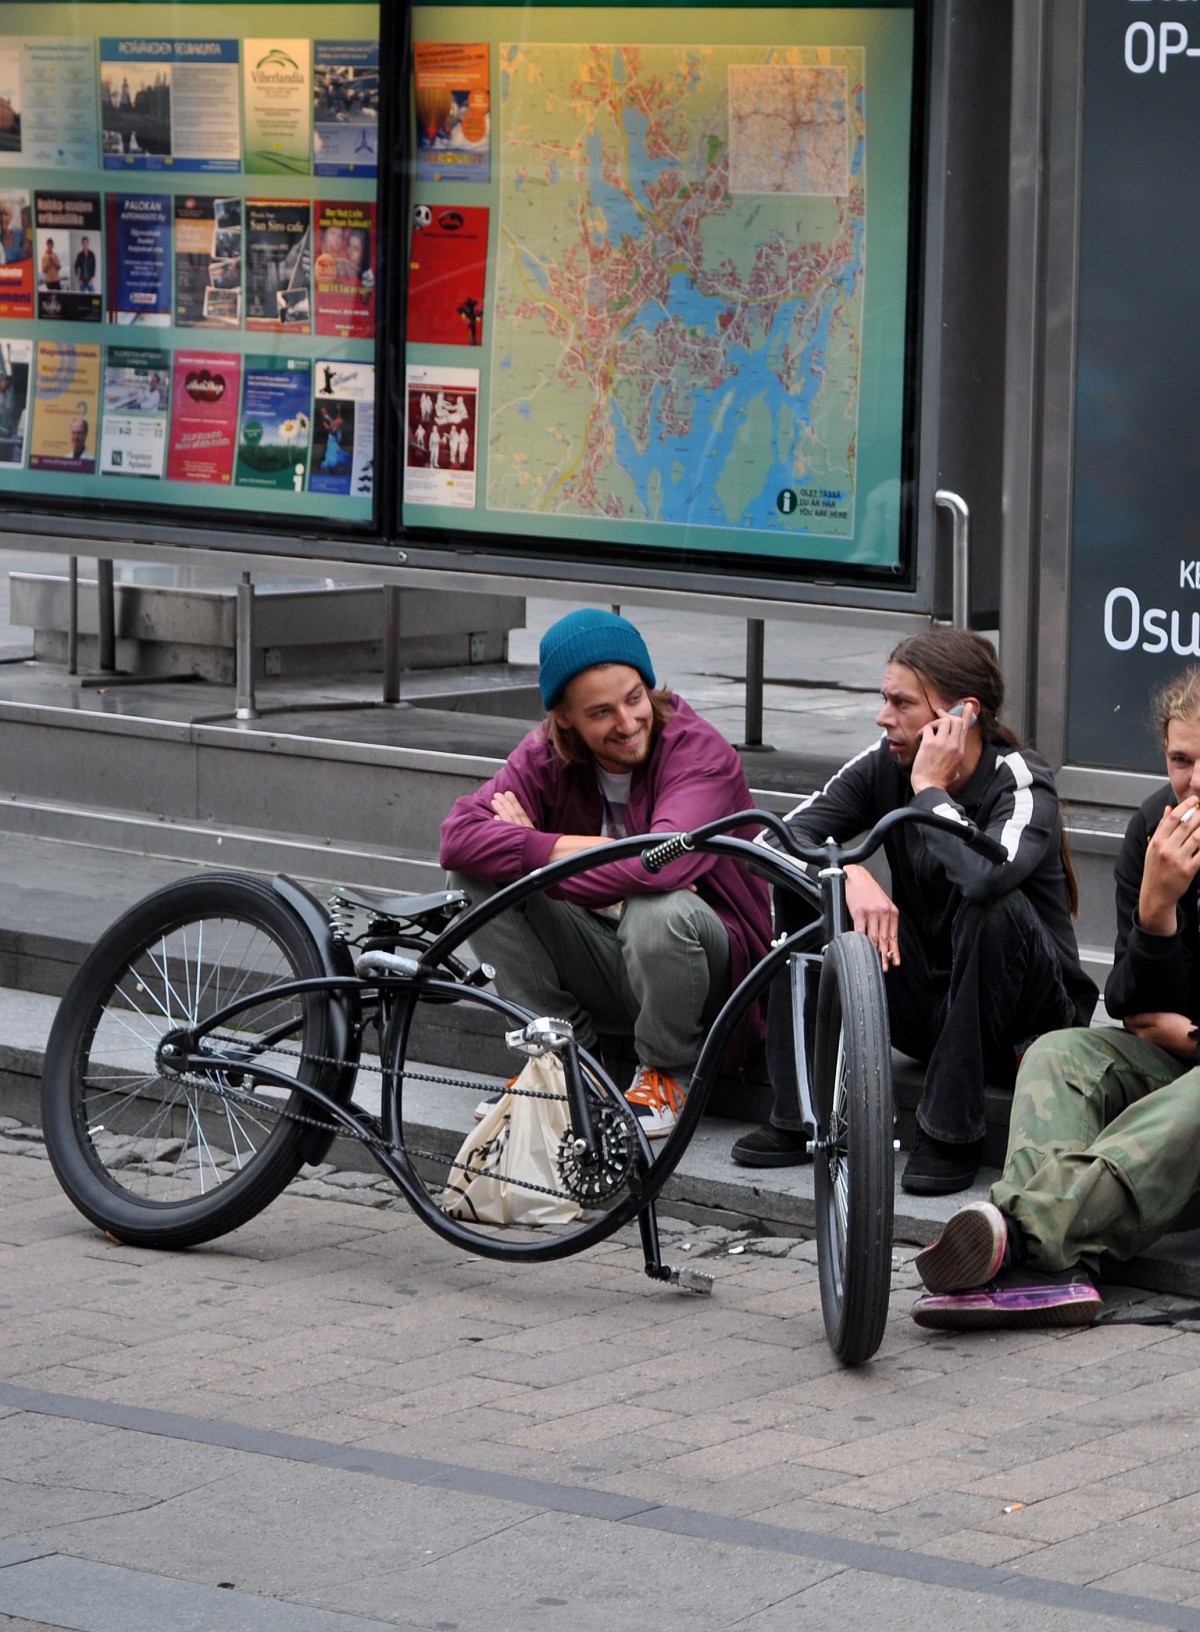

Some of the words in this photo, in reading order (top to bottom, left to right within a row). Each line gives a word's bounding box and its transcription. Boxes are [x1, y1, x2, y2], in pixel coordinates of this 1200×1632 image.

[251, 70, 304, 83] Viherlandia
[124, 200, 162, 211] PALOKAN
[250, 218, 266, 231] San
[800, 488, 817, 497] OLET
[820, 489, 841, 499] TÄSSÄ
[799, 508, 812, 516] YOU
[830, 511, 848, 519] HERE
